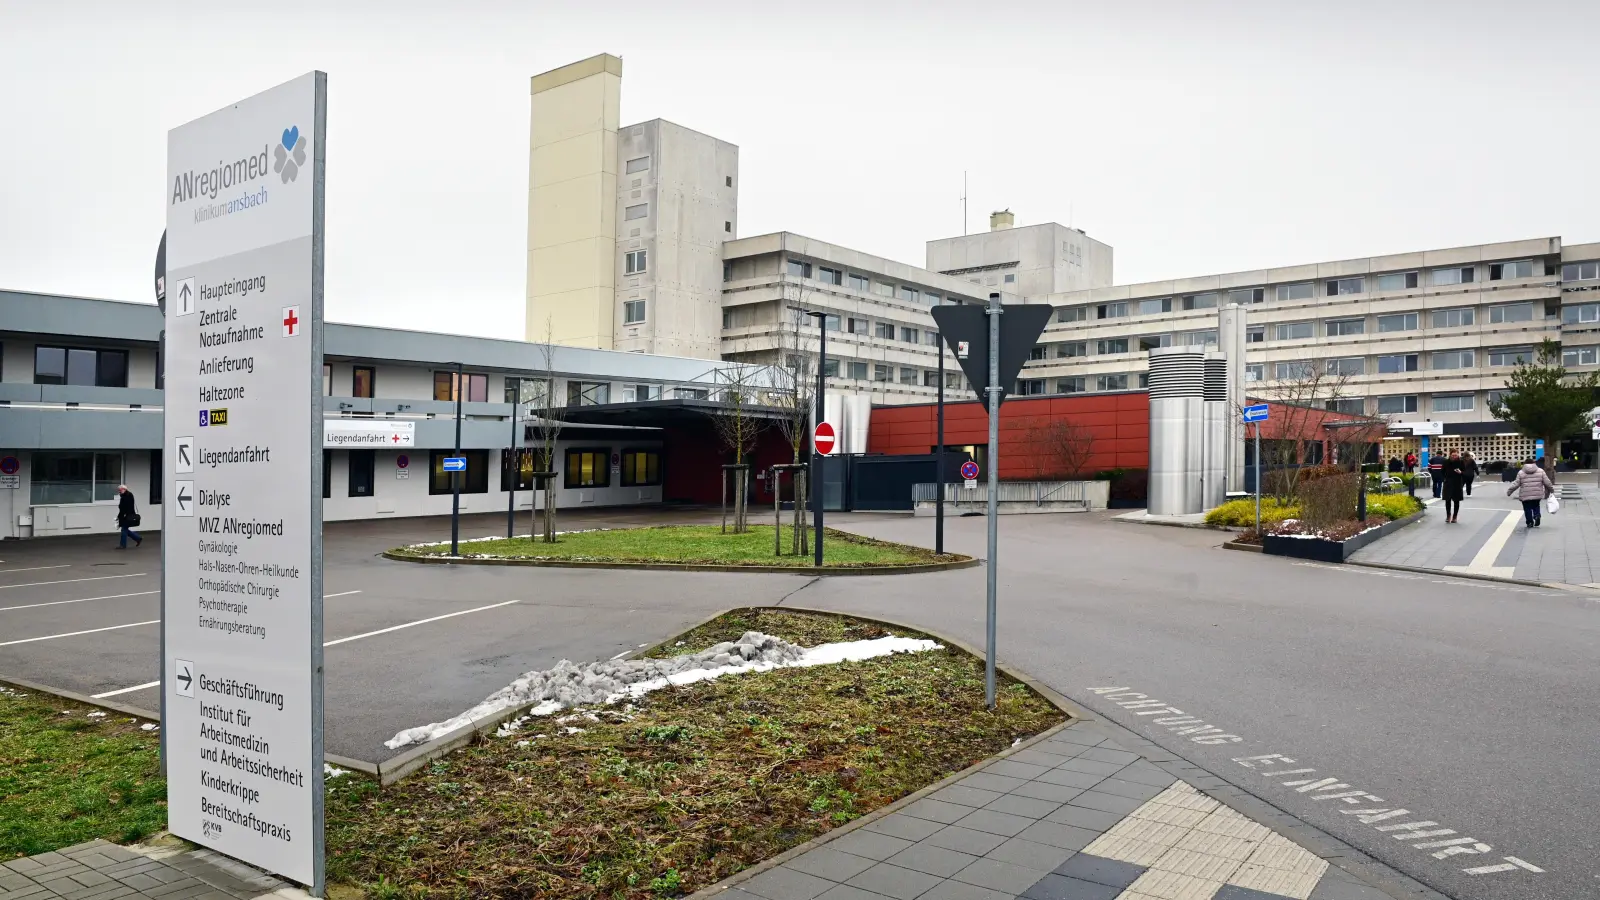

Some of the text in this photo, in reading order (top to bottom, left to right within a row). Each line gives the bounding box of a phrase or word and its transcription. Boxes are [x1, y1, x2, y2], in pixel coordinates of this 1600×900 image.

[172, 144, 268, 205] ANregiomed
[194, 186, 268, 224] klinikumansbach
[200, 275, 266, 301] Haupteingang
[199, 305, 237, 326] Zentrale
[199, 326, 264, 348] Notaufnahme
[199, 355, 254, 375] Anlieferung
[199, 385, 245, 402] Haltezone
[211, 411, 227, 423] TAXI
[327, 433, 386, 444] Liegendanfahrt
[199, 445, 270, 468] Liegendanfahrt
[199, 490, 231, 509] Dialyse
[199, 517, 283, 539] MVZ ANregiomed
[198, 540, 238, 556] Gynäkologie
[198, 559, 299, 579] Hals-Nasen-Ohren-Heilkunde
[198, 578, 280, 600] Orthopädische Chirurgie
[198, 597, 248, 616] Psychotherapie
[199, 616, 266, 639] Ernährungsberatung
[199, 674, 284, 711] Geschäftsführung
[200, 701, 251, 728] Institut für
[200, 723, 269, 755] Arbeitsmedizin
[200, 747, 304, 788] und Arbeitssicherheit
[201, 770, 260, 803] Kinderkrippe
[1086, 686, 1546, 875] ACHTUNG EINFAHRT
[201, 796, 291, 842] Bereitschaftspraxis
[210, 822, 222, 833] KVB
